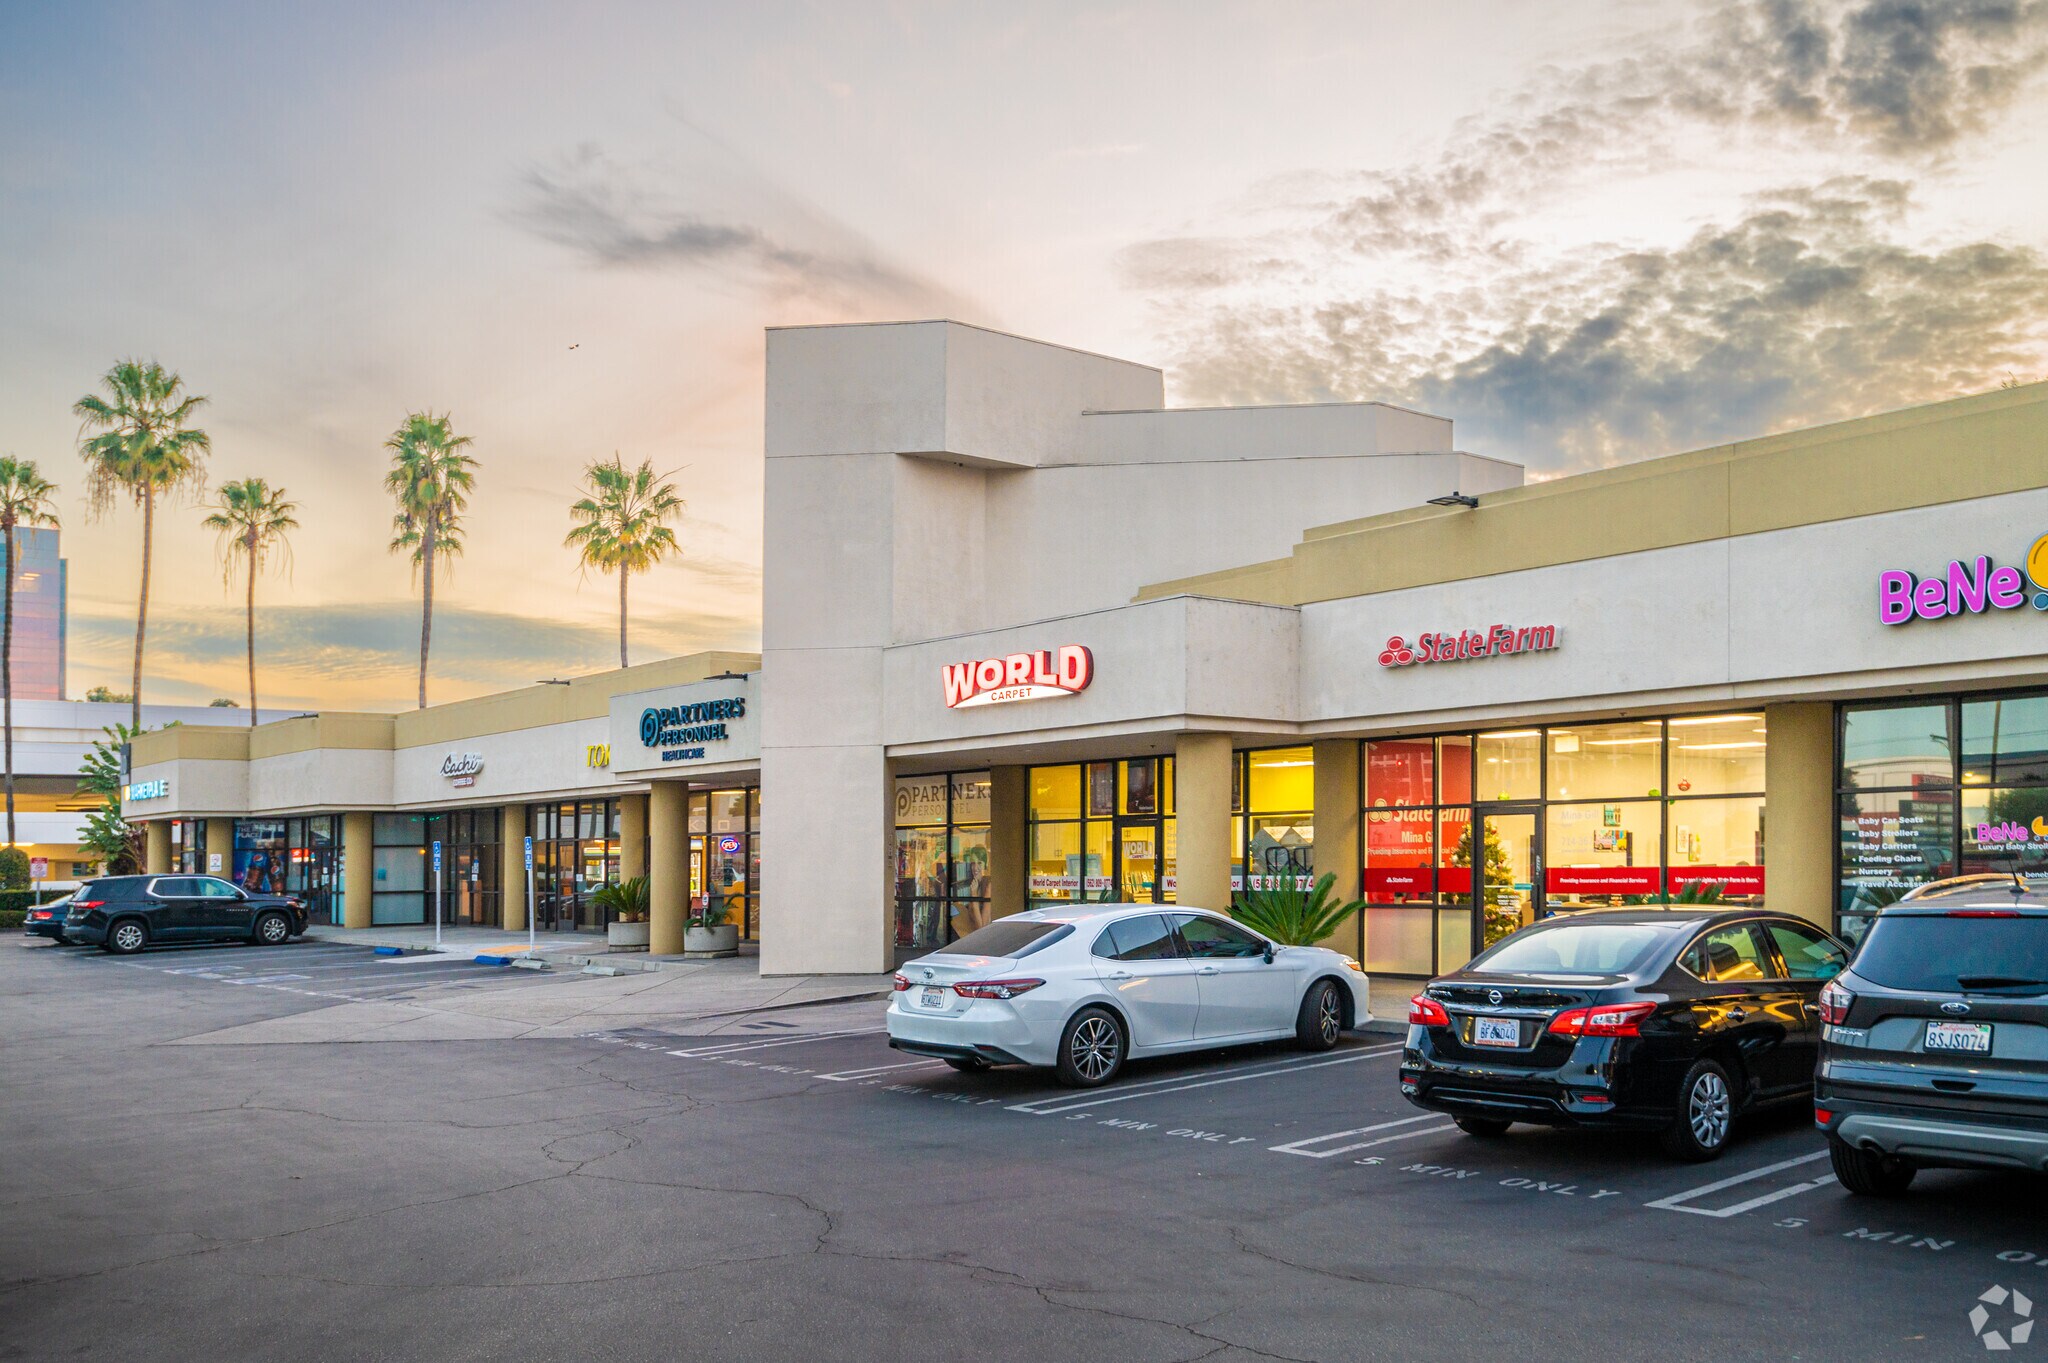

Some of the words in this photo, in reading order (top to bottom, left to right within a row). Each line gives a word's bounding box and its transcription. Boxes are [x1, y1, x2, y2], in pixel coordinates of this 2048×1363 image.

[1879, 555, 2026, 626] BeNe
[941, 645, 1092, 708] WORLD
[991, 688, 1032, 701] CARPET
[659, 697, 745, 727] PARTNERS
[659, 723, 728, 746] PERSONNEL
[662, 747, 705, 761] HEALTHCARE
[1899, 816, 1924, 824] Seats
[1401, 831, 1423, 843] Mina
[1977, 821, 2029, 842] BeNe
[1123, 841, 1153, 857] WORLD
[1858, 843, 1880, 851] Baby
[1978, 844, 2005, 852] Luxury
[1858, 855, 1892, 864] Feeding
[1894, 855, 1922, 863] Chairs
[1858, 868, 1893, 876] Nursery
[1032, 878, 1046, 887] World
[1046, 878, 1061, 888] Carpet
[1061, 878, 1079, 887] Interior
[1928, 1031, 1985, 1050] 8SJS074
[1097, 1118, 1158, 1131] MIN
[1166, 1128, 1257, 1144] ONLY
[1354, 1156, 1386, 1165] 5
[1399, 1163, 1480, 1179] MIN
[1499, 1178, 1622, 1199] ONLY
[1773, 1217, 1809, 1228] 5
[1842, 1227, 1956, 1251] MIN
